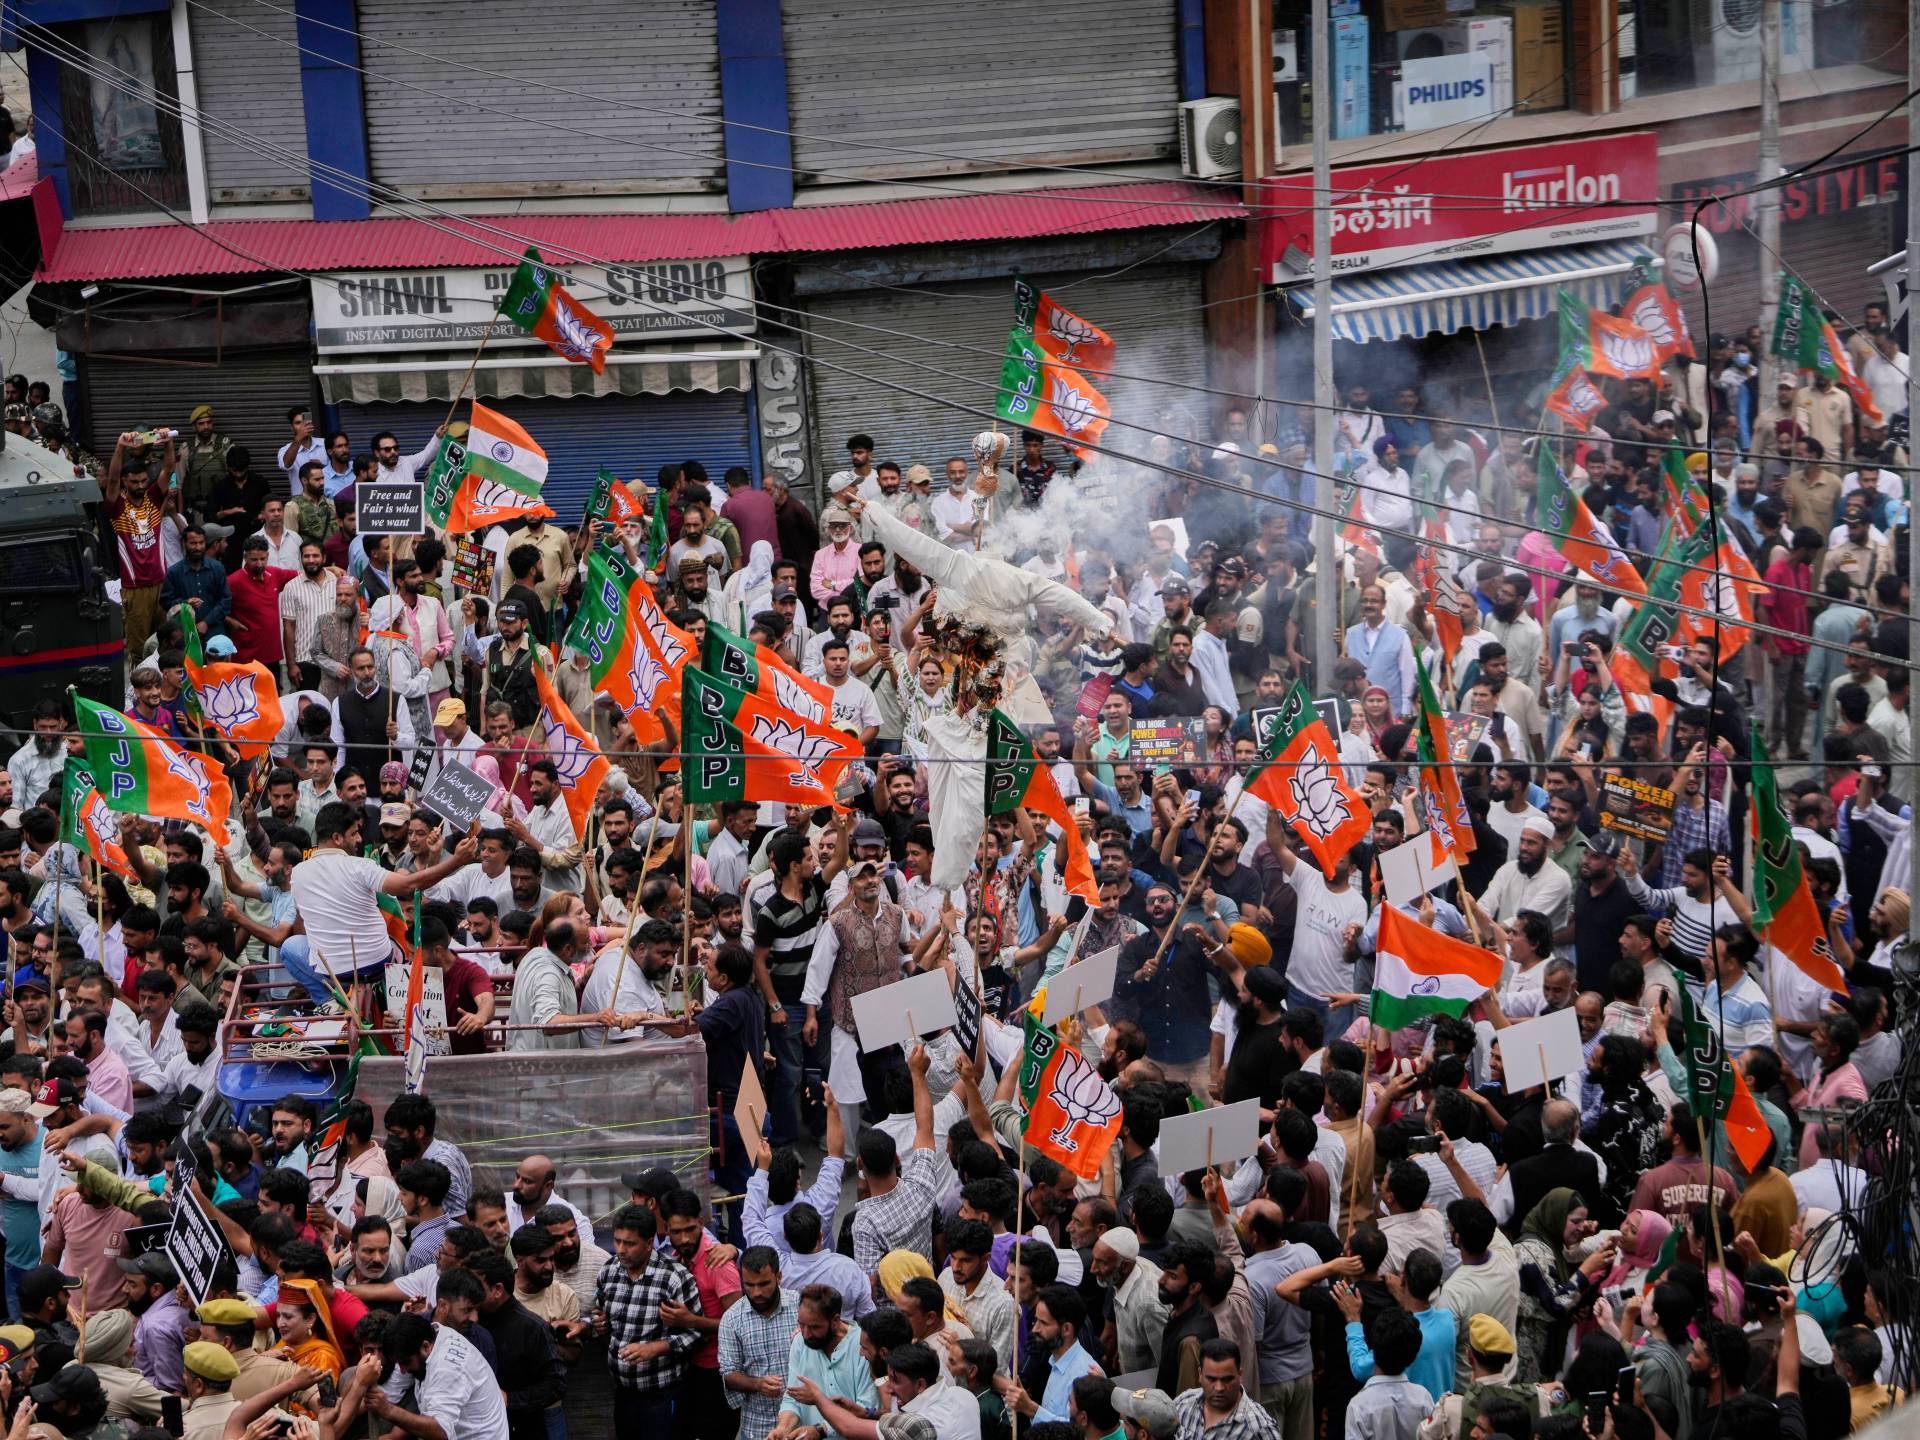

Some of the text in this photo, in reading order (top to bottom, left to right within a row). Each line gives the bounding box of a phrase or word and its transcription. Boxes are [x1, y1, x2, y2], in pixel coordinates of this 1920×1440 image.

[1408, 79, 1485, 105] PHILIPS
[1503, 165, 1619, 213] kurlon
[338, 275, 453, 317] SHAWL
[606, 261, 727, 306] STUDIO
[346, 328, 397, 342] INSTANT
[402, 327, 451, 339] DIGITAL
[456, 324, 514, 338] PASSPORT
[647, 313, 726, 328] LAMINATION
[362, 503, 418, 513] Fair is what
[369, 490, 412, 500] Free and
[371, 518, 409, 527] we want
[1136, 720, 1167, 728] NO MORE
[96, 710, 136, 798] BJP
[1604, 783, 1633, 797] HIKE
[1605, 773, 1675, 801] POWER
[388, 985, 442, 1001] Cortion
[180, 1195, 204, 1235] PROMOTE
[200, 1231, 218, 1263] MERIT
[184, 1226, 204, 1265] FINISH
[172, 1229, 206, 1294] CORRUPTION
